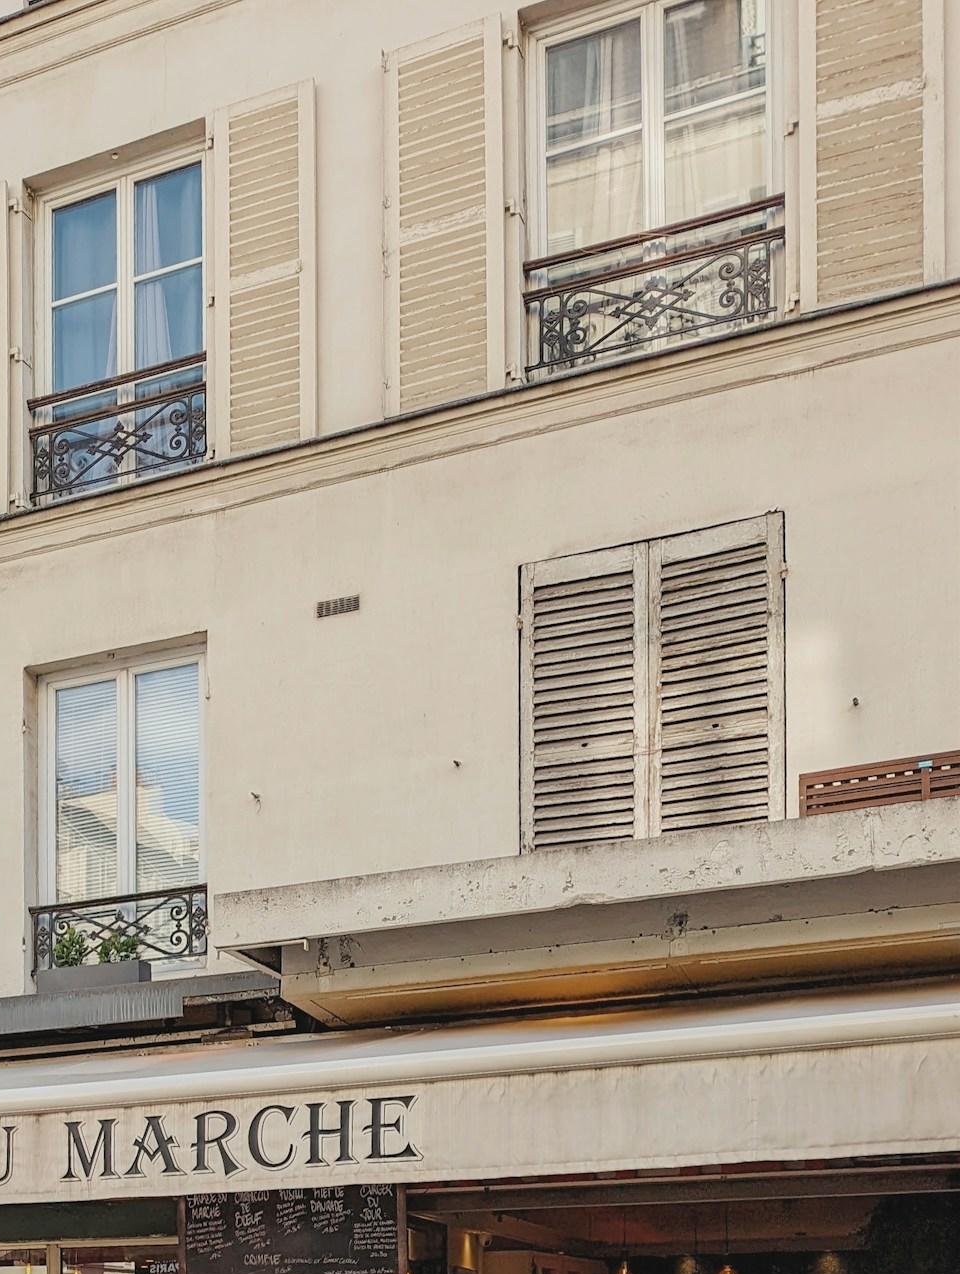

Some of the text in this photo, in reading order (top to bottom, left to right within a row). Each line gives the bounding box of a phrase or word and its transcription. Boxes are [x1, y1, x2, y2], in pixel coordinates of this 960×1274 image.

[60, 1093, 425, 1182] MARCHE
[240, 1202, 251, 1214] DE
[367, 1197, 379, 1207] DU
